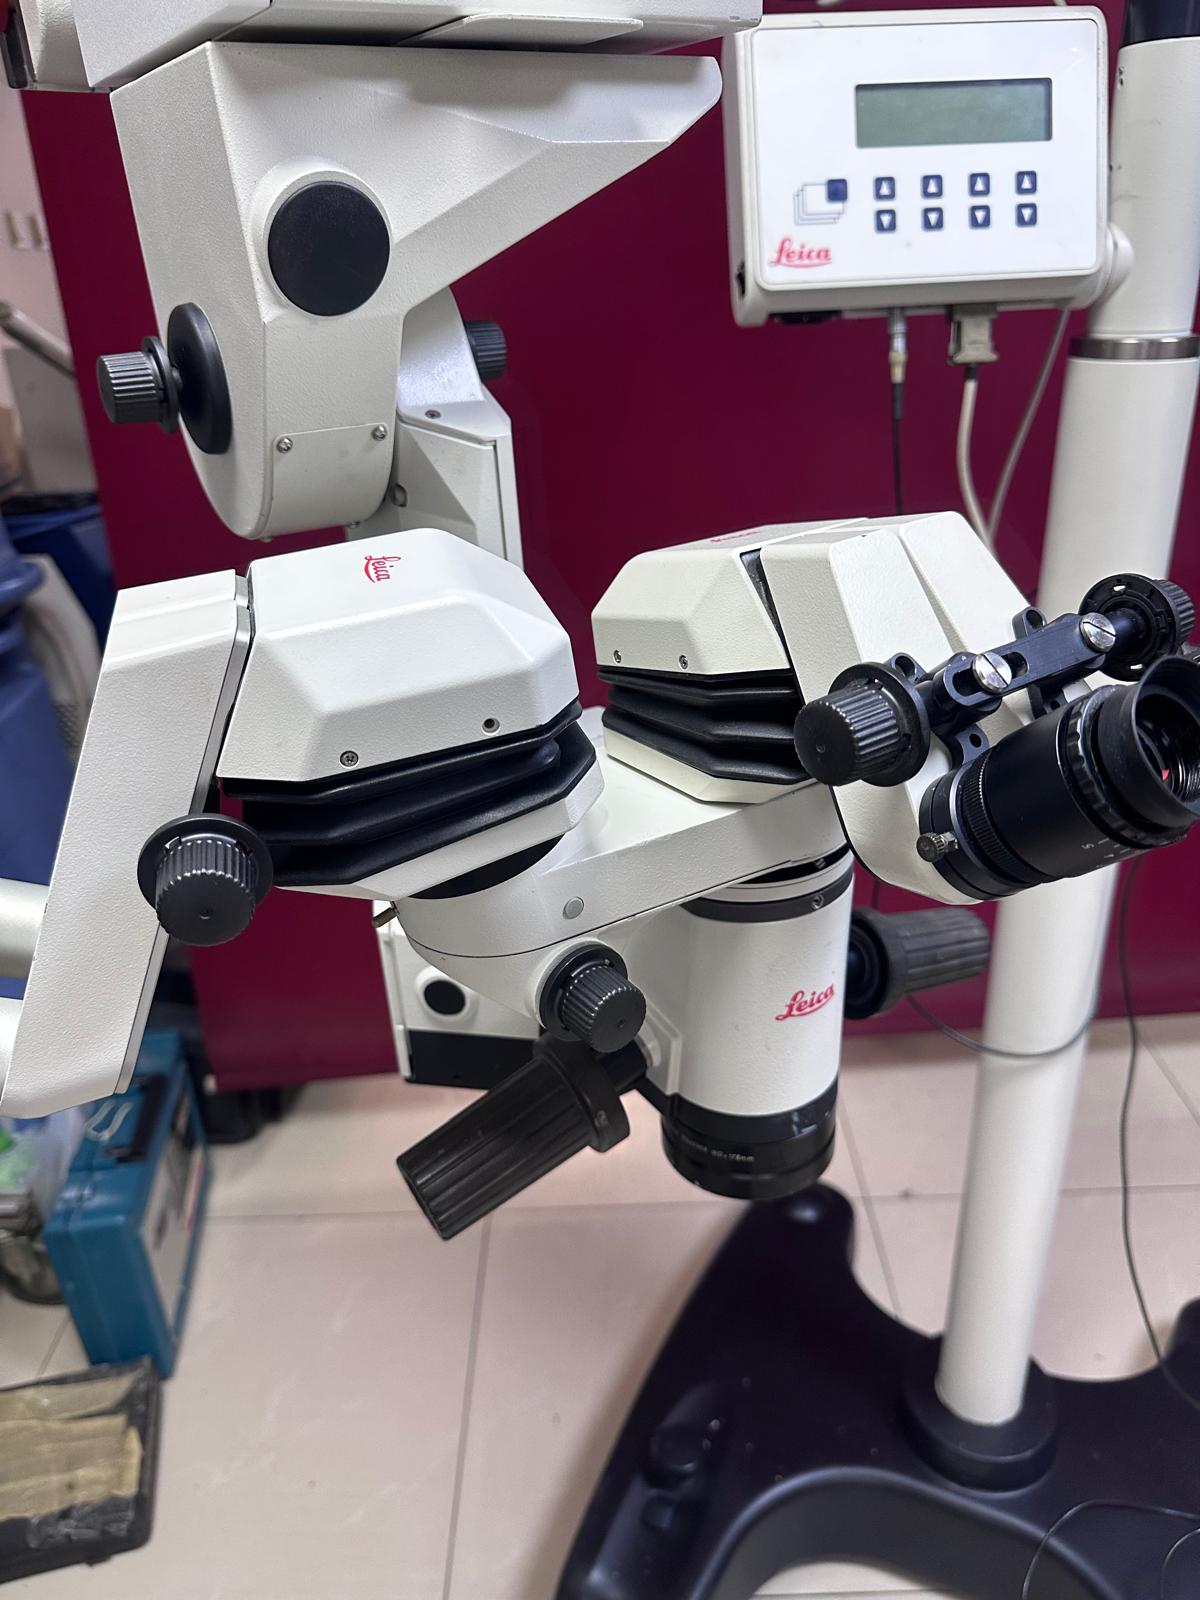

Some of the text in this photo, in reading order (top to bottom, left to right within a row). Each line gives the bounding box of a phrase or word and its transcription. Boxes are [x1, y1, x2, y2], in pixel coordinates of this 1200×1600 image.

[768, 238, 832, 268] Leica
[364, 555, 401, 583] Leica
[775, 984, 834, 1021] Leica
